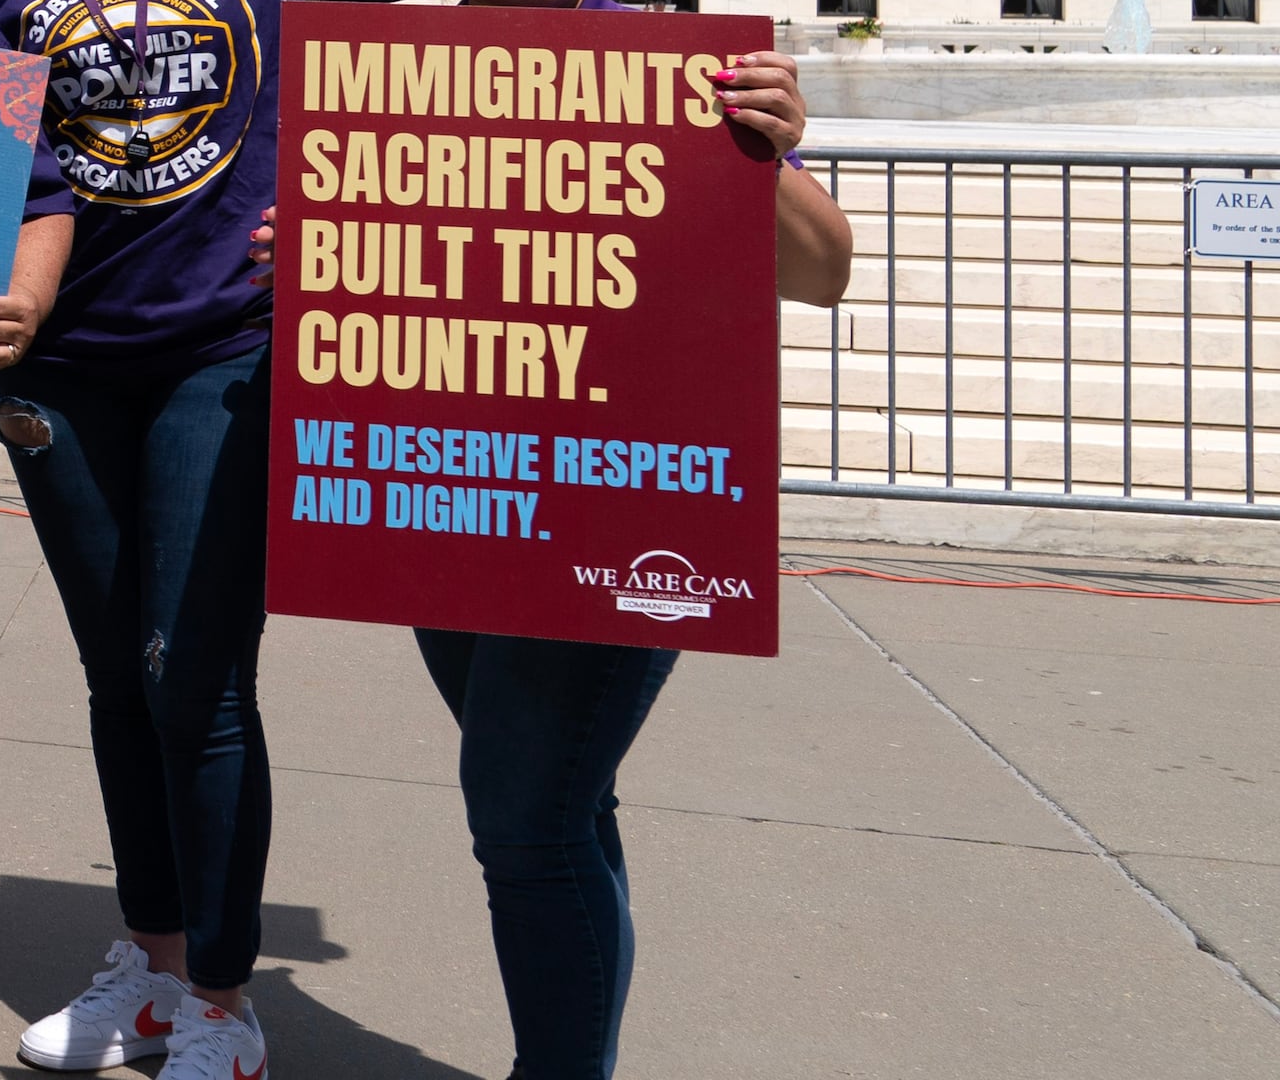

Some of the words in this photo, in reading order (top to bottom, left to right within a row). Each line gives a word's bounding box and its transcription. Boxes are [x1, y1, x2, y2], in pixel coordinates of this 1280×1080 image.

[68, 43, 112, 69] WE
[51, 52, 219, 111] POWER
[148, 96, 177, 109] SEIU
[152, 127, 188, 152] PEOPLE
[54, 135, 221, 193] ORGANIZERS
[301, 129, 666, 218] SACRIFICES
[1215, 192, 1274, 208] AREA
[1212, 223, 1222, 231] By
[299, 219, 473, 301] BUILT
[494, 229, 638, 309] THIS
[297, 309, 608, 402] COUNTRY.
[294, 418, 354, 468] WE
[367, 423, 540, 483] DESERVE
[553, 437, 744, 502] RESPECT,
[292, 475, 372, 527] AND
[386, 482, 552, 542] DIGNITY.
[572, 565, 618, 587] WE
[624, 570, 680, 592] ARE
[684, 575, 757, 600] CASA
[623, 600, 673, 612] COMMUNITY
[674, 604, 704, 614] POWER
